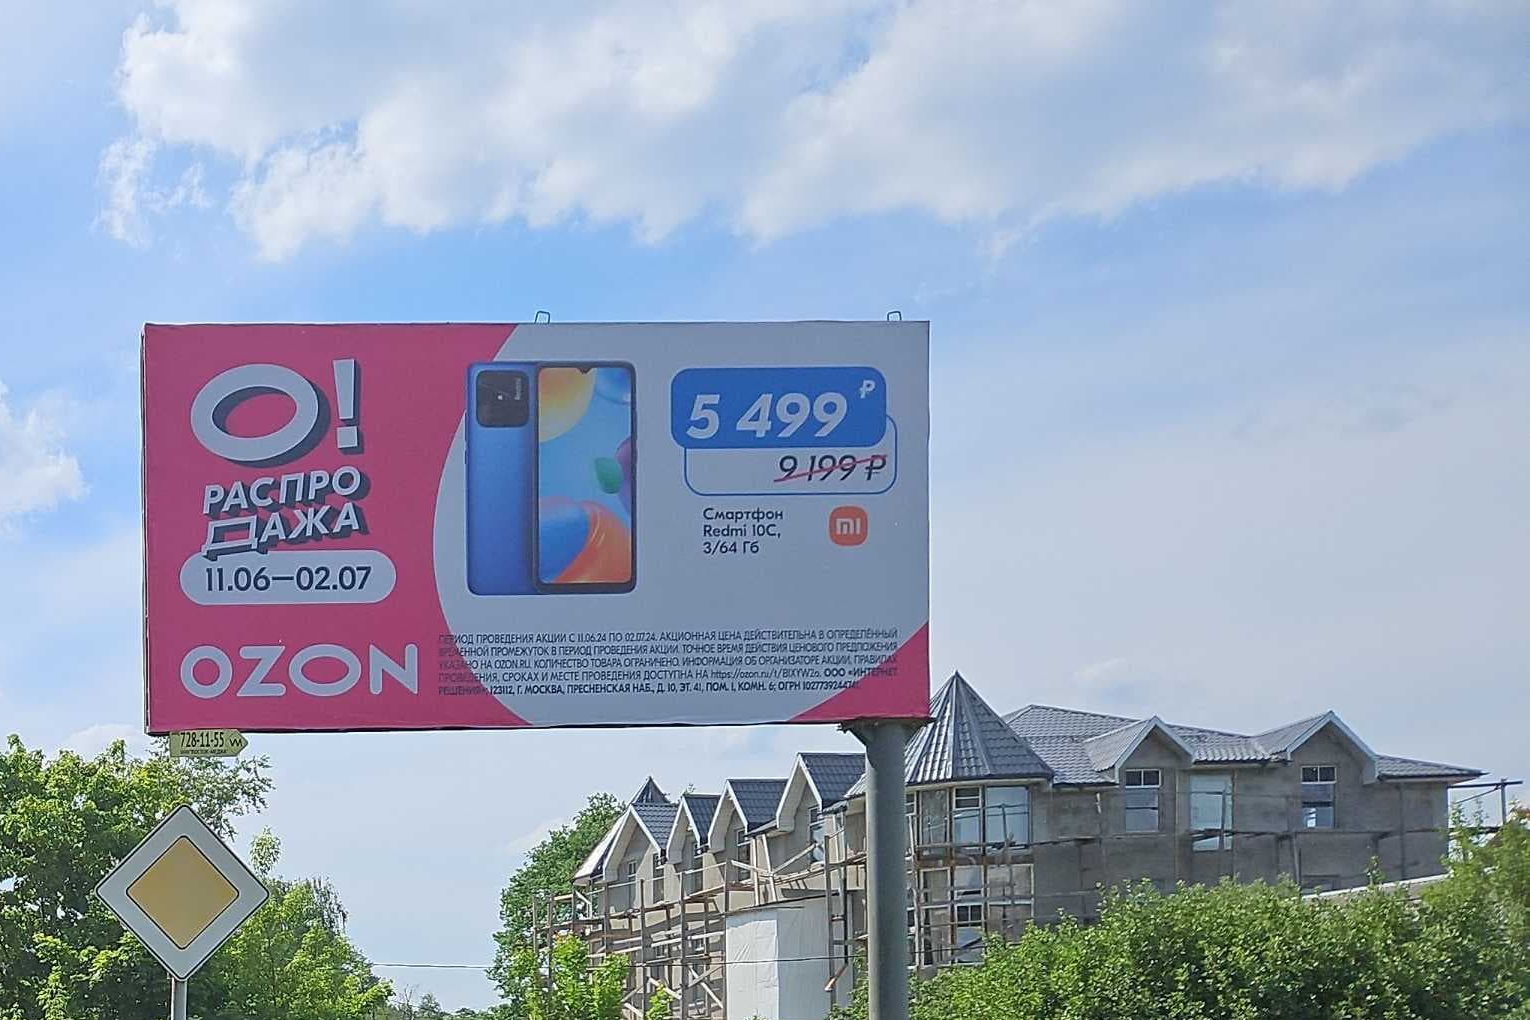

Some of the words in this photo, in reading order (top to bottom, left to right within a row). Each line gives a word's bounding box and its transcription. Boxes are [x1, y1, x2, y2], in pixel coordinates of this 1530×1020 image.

[190, 359, 359, 462] О!
[686, 393, 720, 440] 5
[736, 391, 848, 438] 499
[779, 454, 798, 482] 9
[807, 453, 857, 481] 199
[203, 465, 365, 514] РАСПРО
[702, 507, 783, 524] Смартфон
[201, 502, 361, 553] ДАЖА
[702, 523, 747, 537] Redmi
[702, 541, 737, 555] 3/64
[743, 541, 759, 554] Гб
[476, 633, 534, 644] ПРОВЕДЕНИЯ
[536, 633, 567, 644] АКЦИИ
[608, 632, 623, 642] ПО
[659, 631, 716, 642] АКЦИОННАЯ
[718, 631, 742, 641] ЦЕНА
[743, 629, 817, 641] ДЕЙСТВИТЕЛЬНА
[818, 630, 824, 640] В
[491, 646, 549, 656] ПРОМЕЖУТОК
[551, 646, 557, 656] В
[558, 645, 592, 656] ПЕРИОД
[593, 645, 648, 656] ПРОВЕДЕНИЯ
[682, 643, 715, 654] ТОЧНОЕ
[717, 643, 744, 653] ВРЕМЯ
[745, 641, 787, 653] ДЕЙСТВИЯ
[789, 642, 834, 653] ЦЕНОВОГО
[836, 641, 898, 652] ПРЕДЛОЖЕНИЯ
[480, 660, 492, 669] НА
[533, 659, 589, 669] КОЛИЧЕСТВО
[590, 658, 622, 668] ТОВАРА
[682, 656, 743, 667] ИНФОРМАЦИЯ
[744, 656, 757, 666] ОБ
[758, 655, 820, 665] ОРГАНИЗАТОРЕ
[180, 643, 418, 699] OZON
[502, 672, 539, 682] СРОКАХ
[541, 672, 548, 681] И
[550, 671, 579, 681] МЕСТЕ
[581, 670, 641, 681] ПРОВЕДЕНИЯ
[643, 669, 693, 681] ДОСТУПНА
[695, 669, 709, 679] НА
[823, 668, 846, 677] ООО
[524, 684, 565, 695] МОСКВА,
[566, 683, 631, 694] ПРЕСНЕНСКАЯ
[705, 682, 729, 692] ПОМ.
[738, 681, 767, 692] КОМН.
[778, 681, 801, 691] ОГРН
[180, 731, 225, 748] 728-11-55
